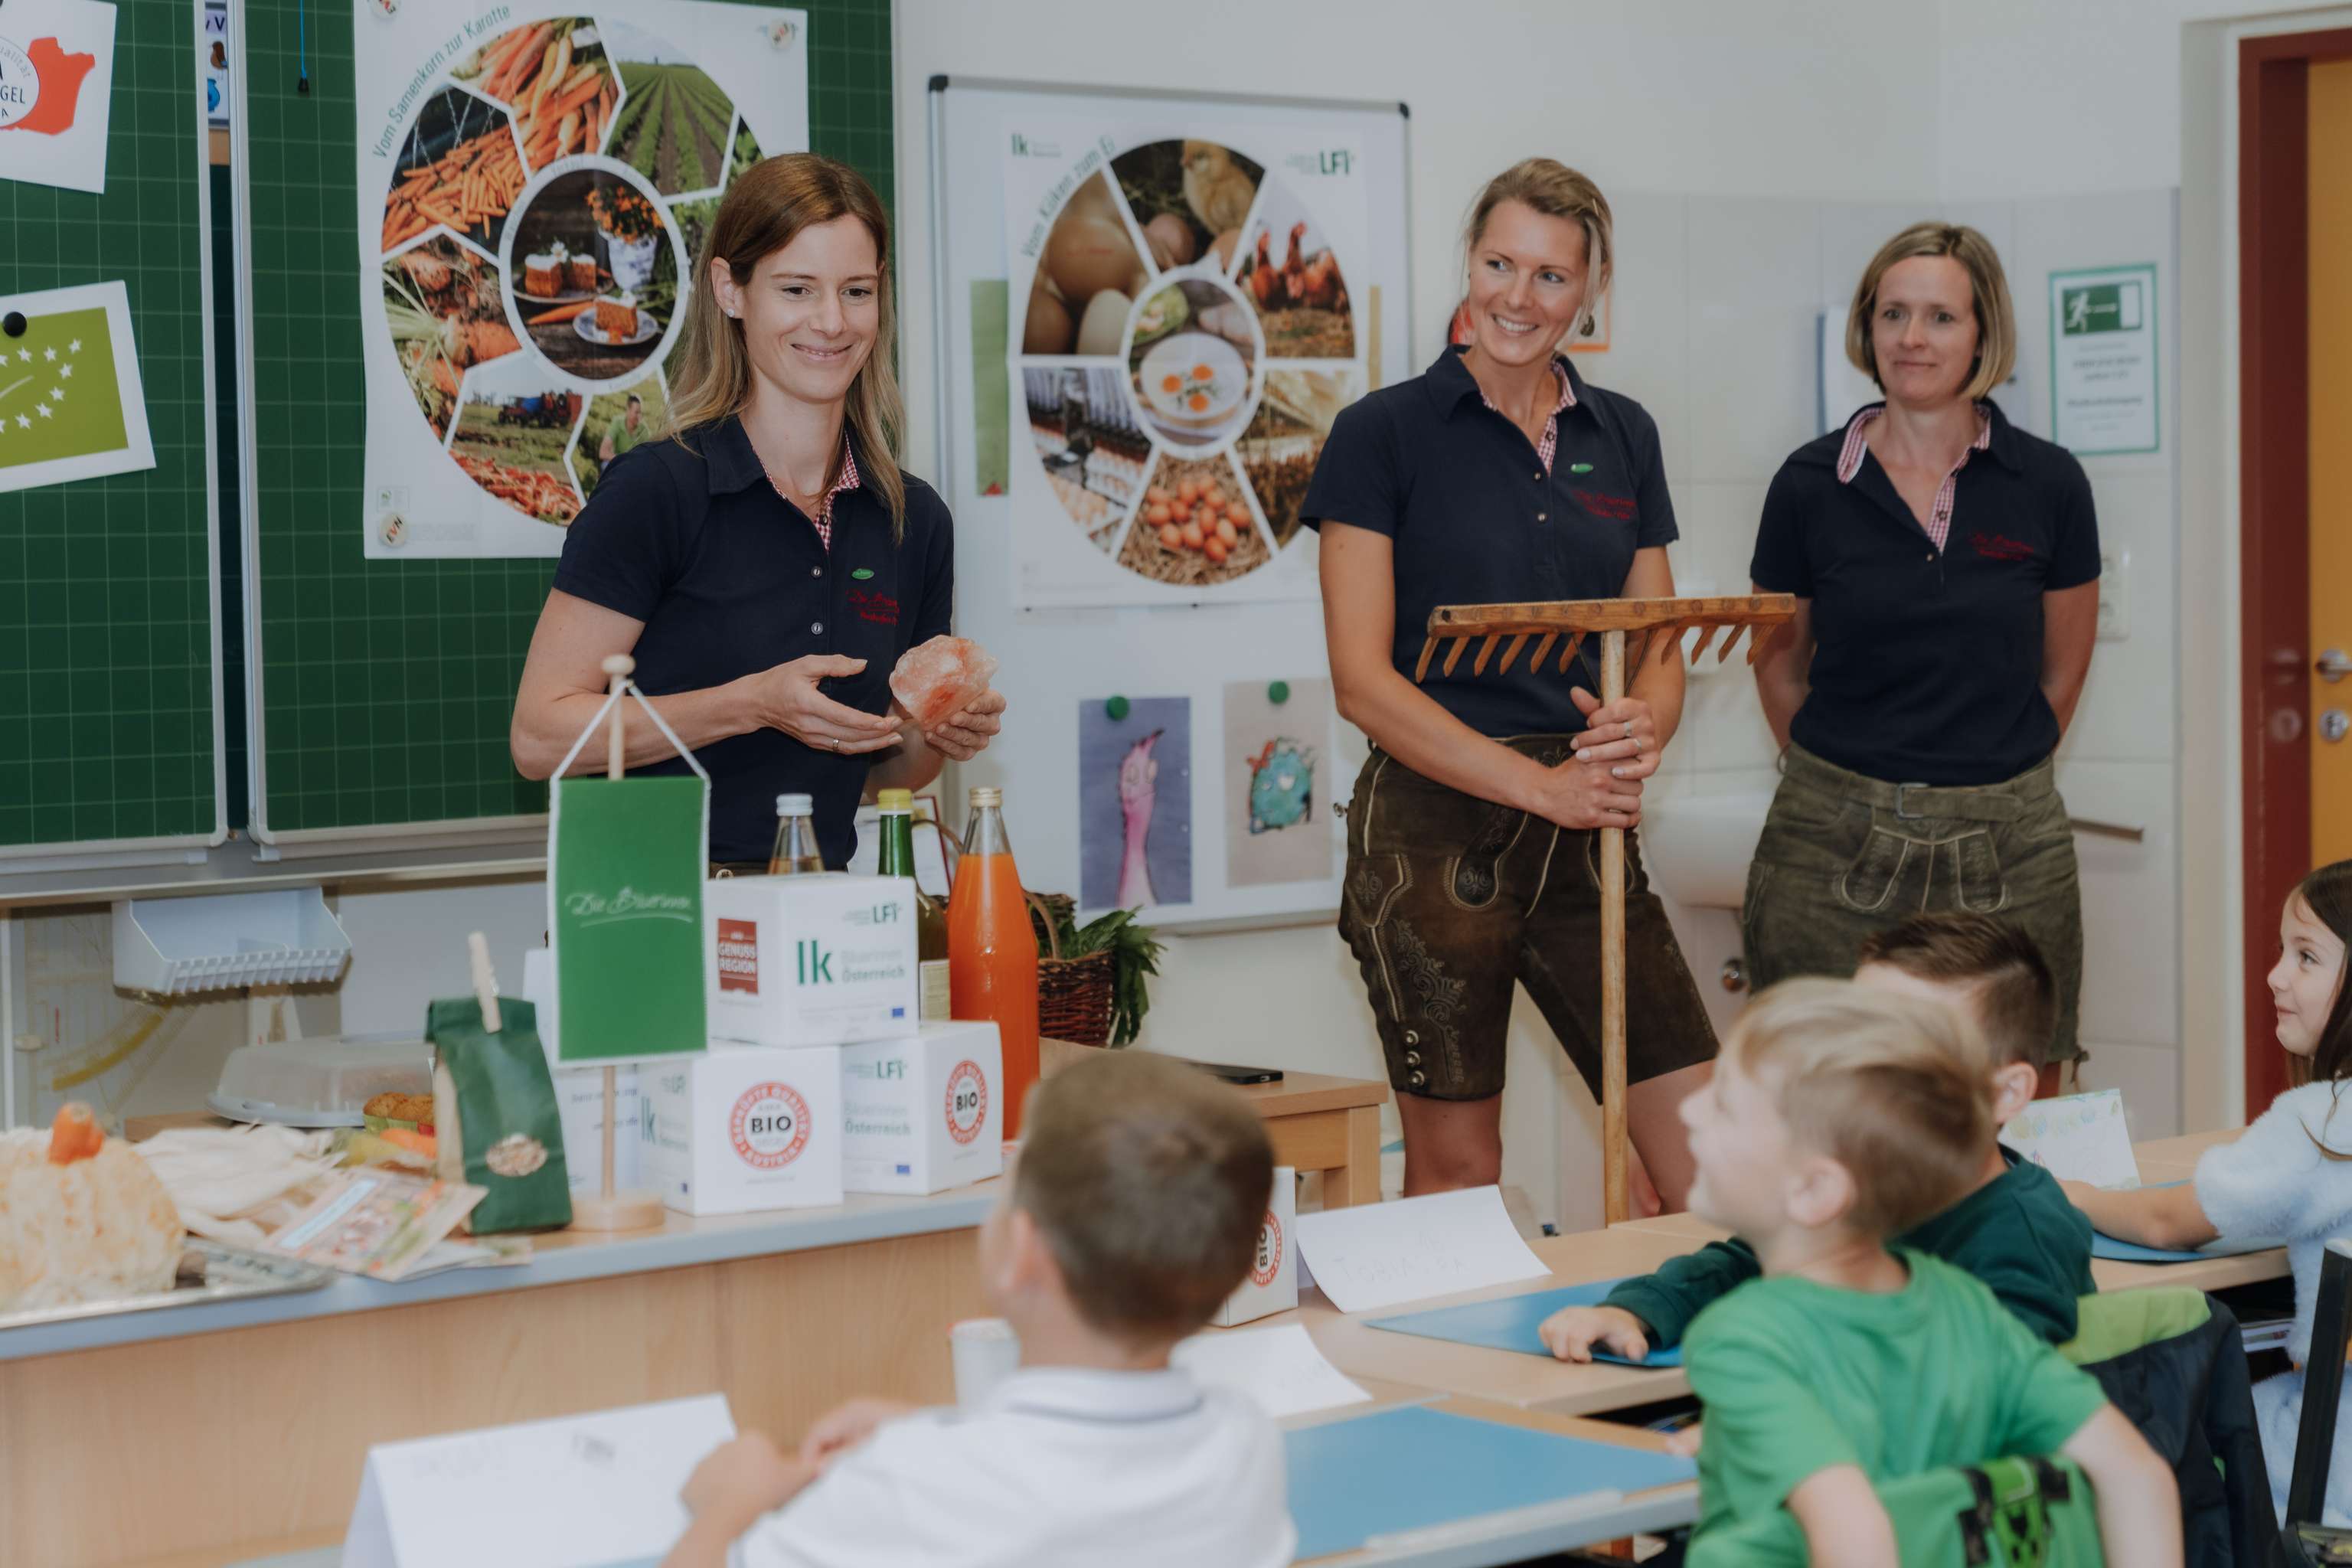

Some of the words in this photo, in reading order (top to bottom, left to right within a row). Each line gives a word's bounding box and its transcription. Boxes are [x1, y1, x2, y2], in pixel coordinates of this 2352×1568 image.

[374, 124, 397, 159] Vom
[388, 51, 445, 124] Samenkorn
[444, 34, 463, 56] zur
[463, 5, 511, 39] Karotte
[842, 962, 906, 983] Österreich
[956, 1091, 978, 1112] BIO
[750, 1116, 792, 1134] BIO
